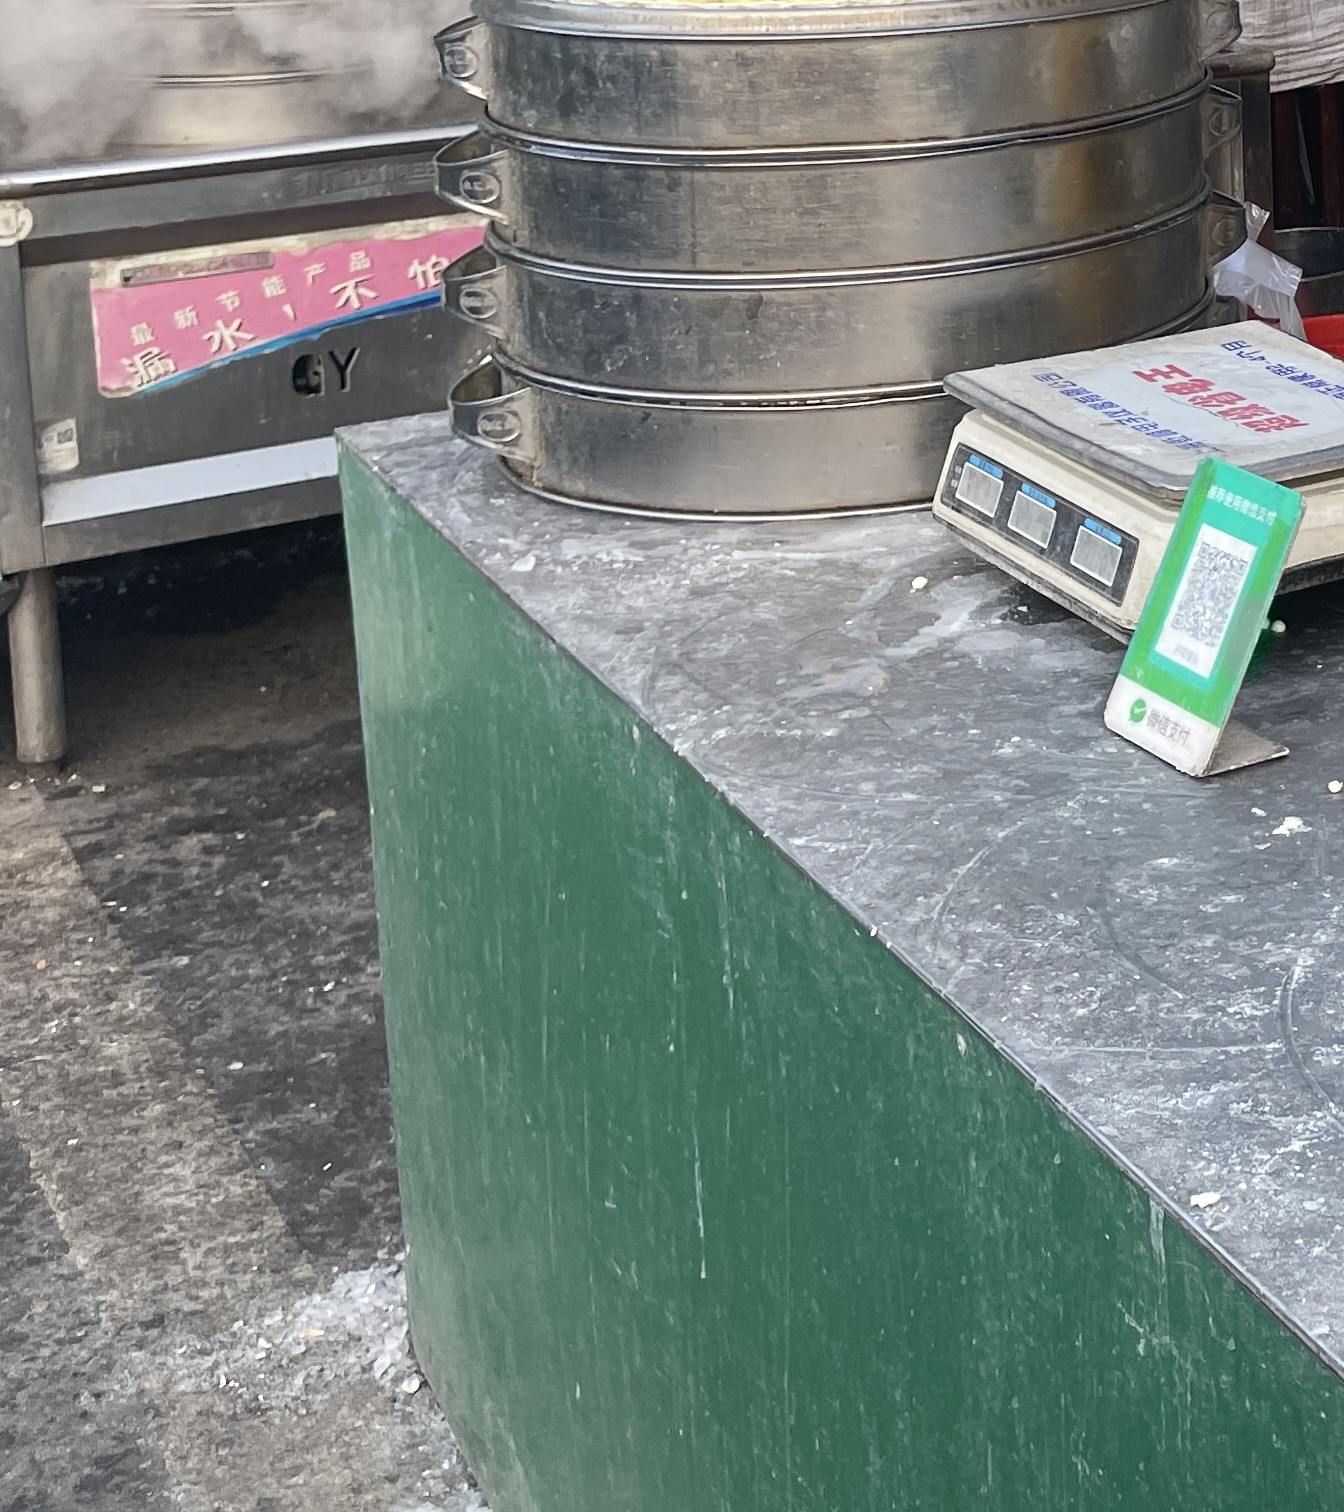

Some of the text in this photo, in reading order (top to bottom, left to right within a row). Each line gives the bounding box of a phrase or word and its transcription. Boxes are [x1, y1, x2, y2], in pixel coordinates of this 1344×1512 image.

[1132, 364, 1309, 433] 超级省电王
[1146, 708, 1190, 746] 微信支付
